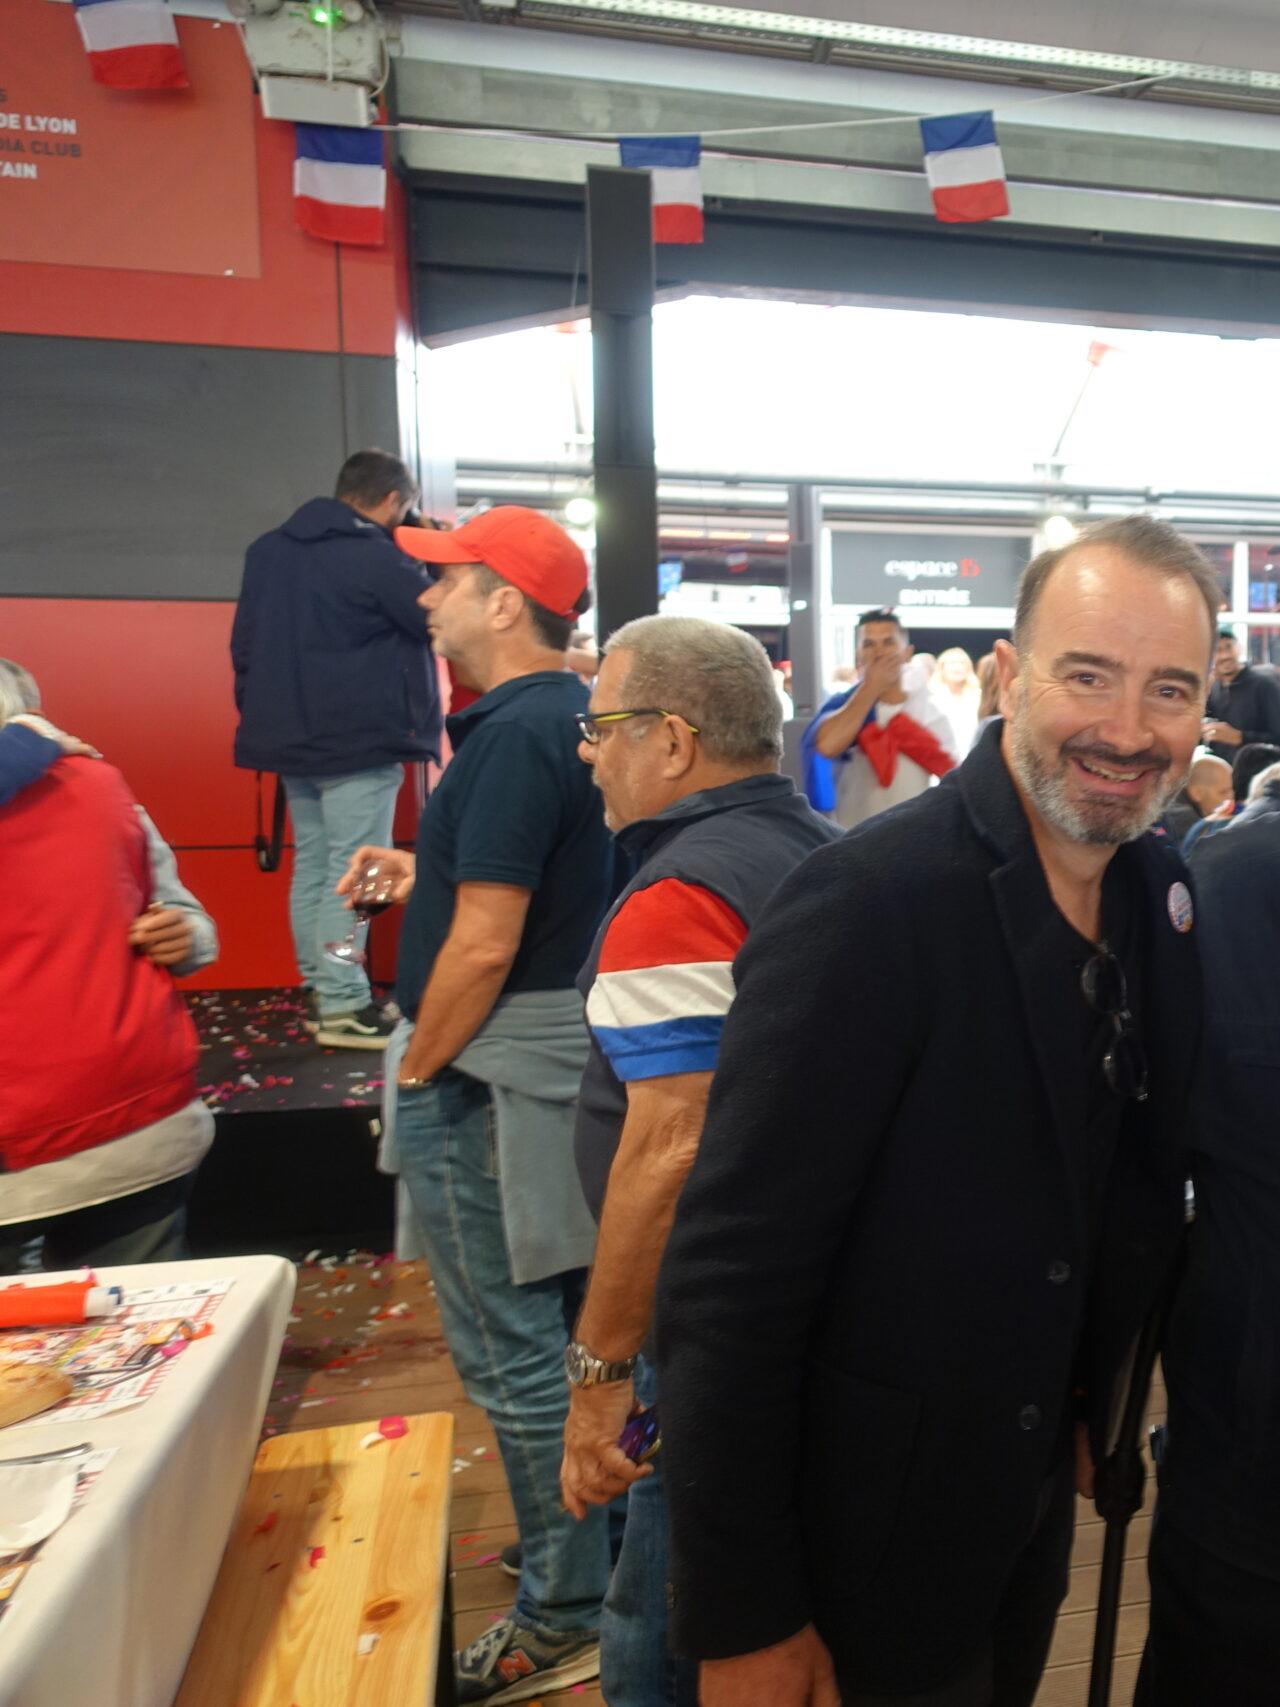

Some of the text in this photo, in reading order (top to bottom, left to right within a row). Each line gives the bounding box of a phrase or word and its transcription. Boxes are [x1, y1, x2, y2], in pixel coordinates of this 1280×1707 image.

[24, 115, 77, 135] LYON
[30, 141, 82, 158] CLUB
[0, 161, 38, 179] AIN
[884, 559, 958, 581] espace
[899, 586, 970, 605] ENTRÉE
